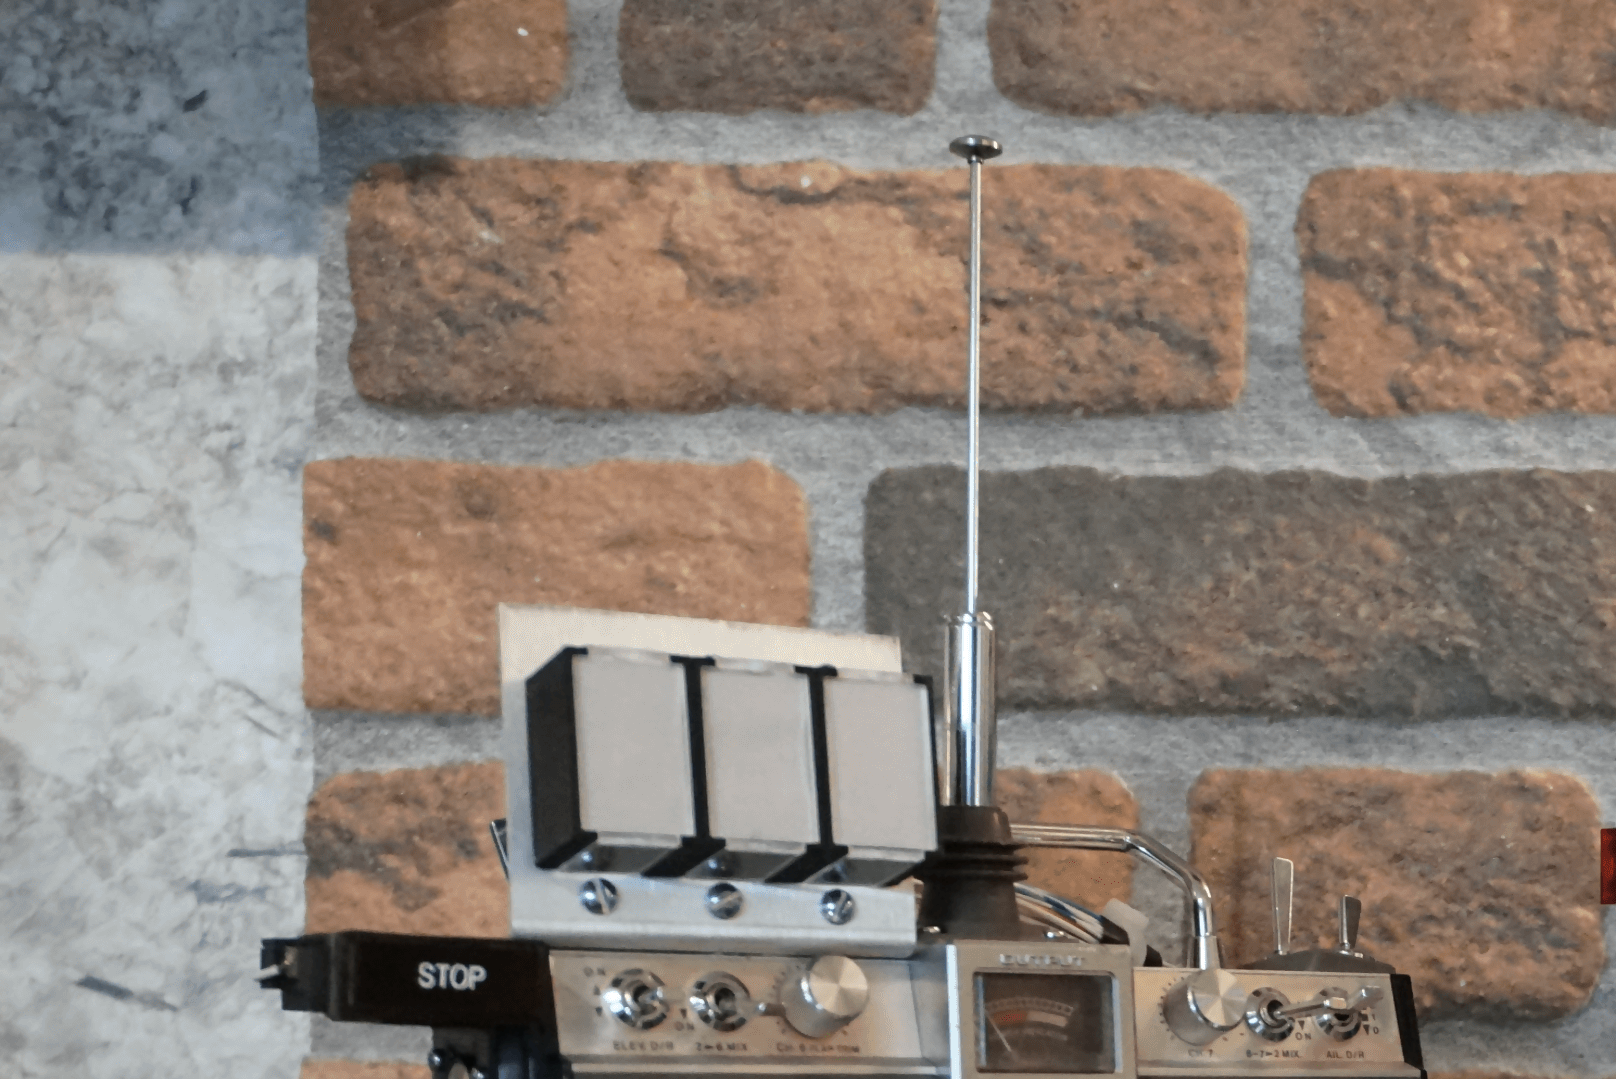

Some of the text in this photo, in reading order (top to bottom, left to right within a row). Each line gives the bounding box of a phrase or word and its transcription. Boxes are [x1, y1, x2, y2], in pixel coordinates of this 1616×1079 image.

[417, 961, 488, 991] STOP
[1294, 1032, 1312, 1041] ON
[1282, 1050, 1300, 1059] MIX
